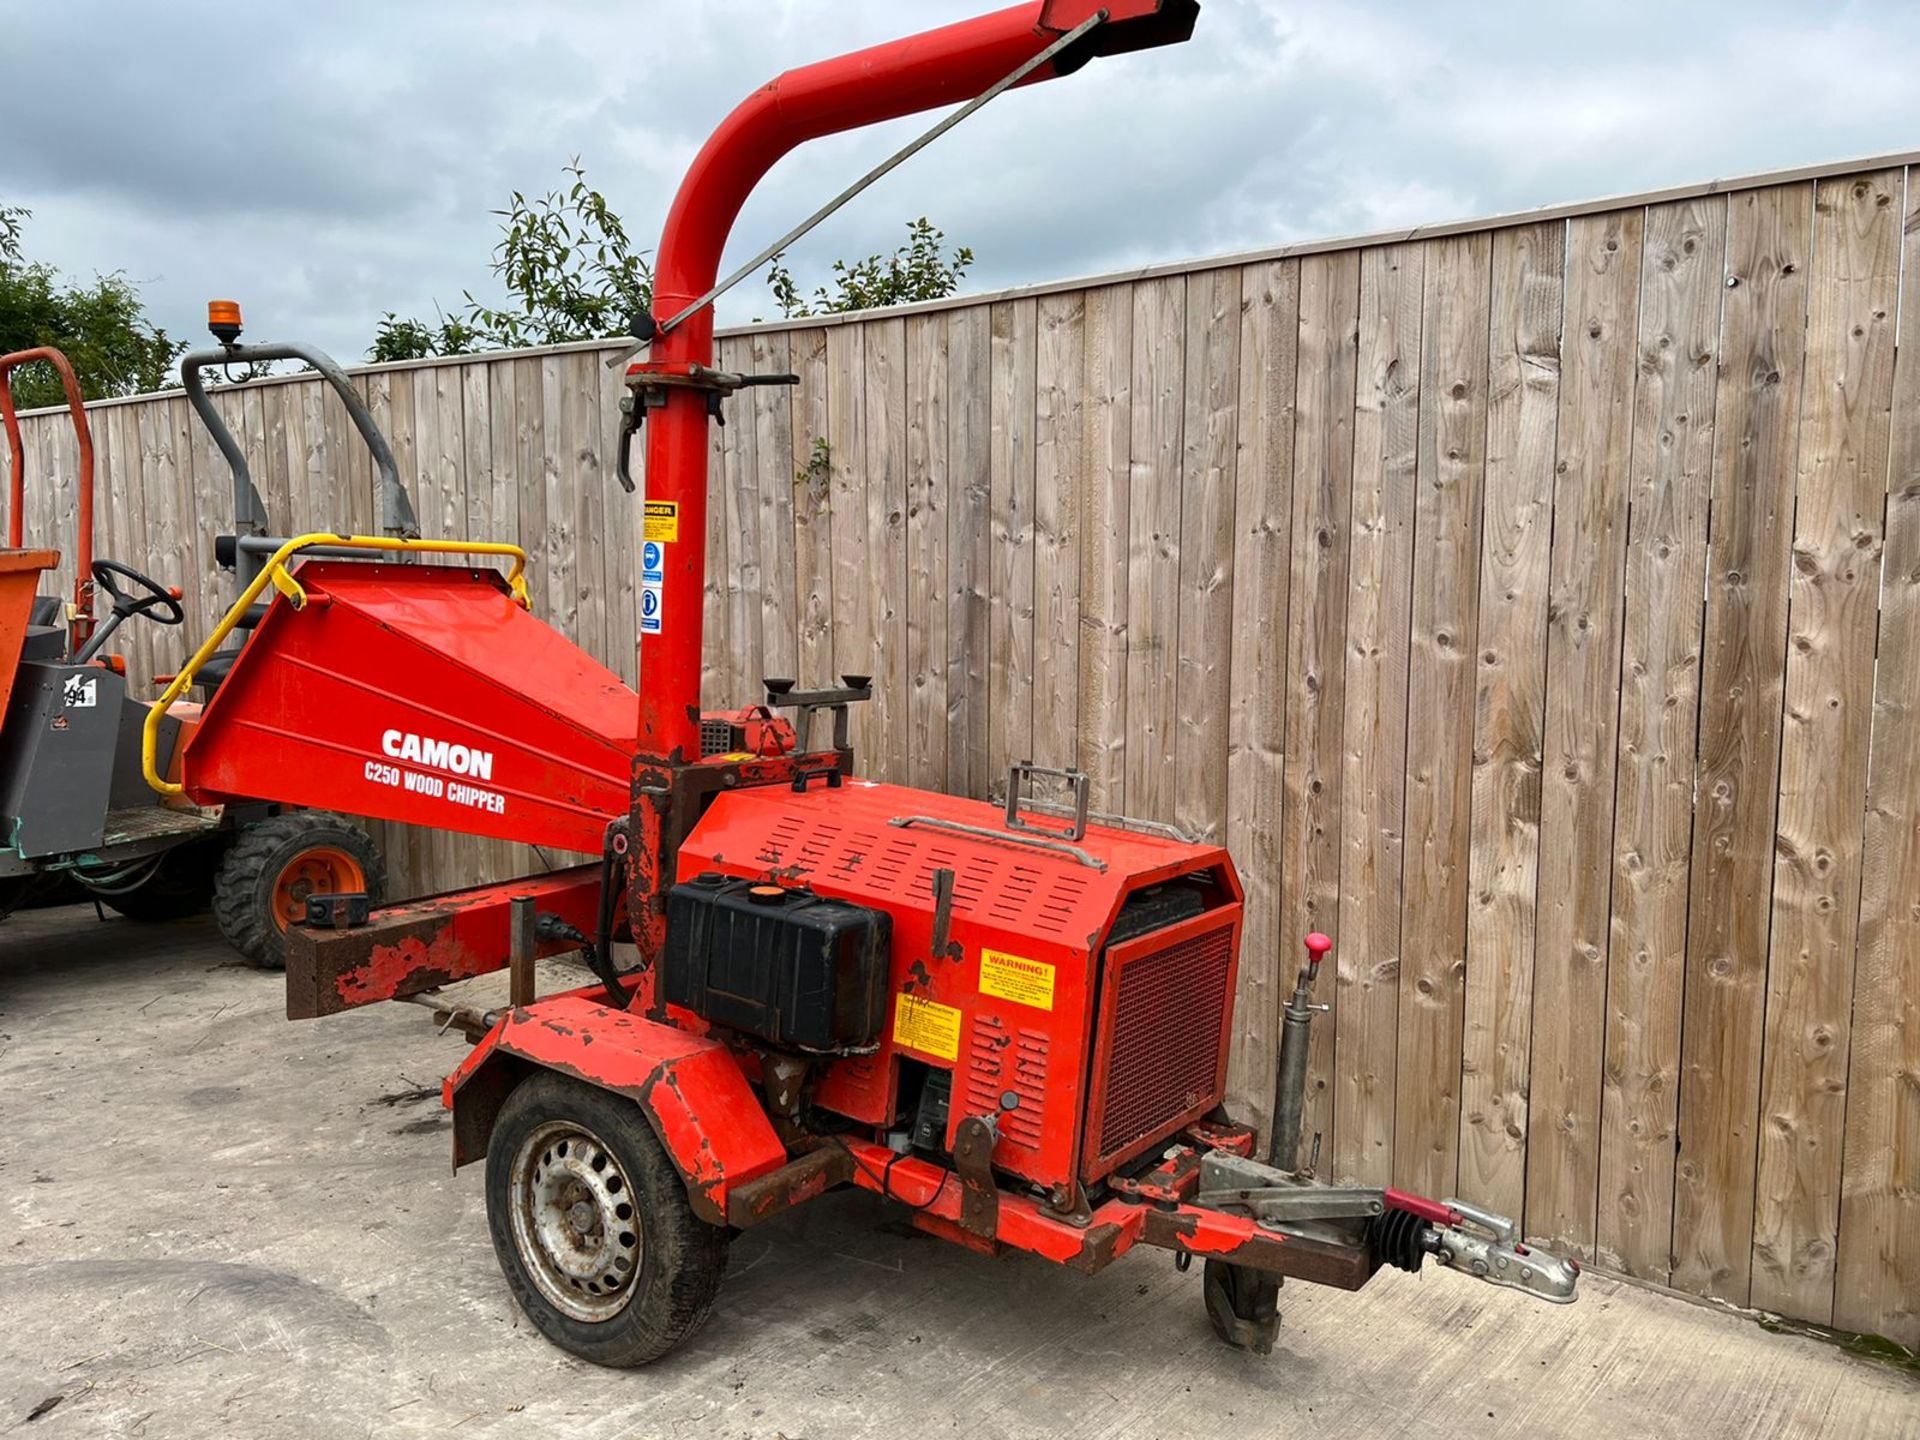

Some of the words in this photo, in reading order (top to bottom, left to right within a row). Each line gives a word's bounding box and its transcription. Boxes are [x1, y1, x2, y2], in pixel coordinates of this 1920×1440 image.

[382, 729, 493, 780] CAMON
[365, 761, 399, 786] C250
[404, 771, 443, 797] WOOD
[448, 783, 505, 814] CHIPPER
